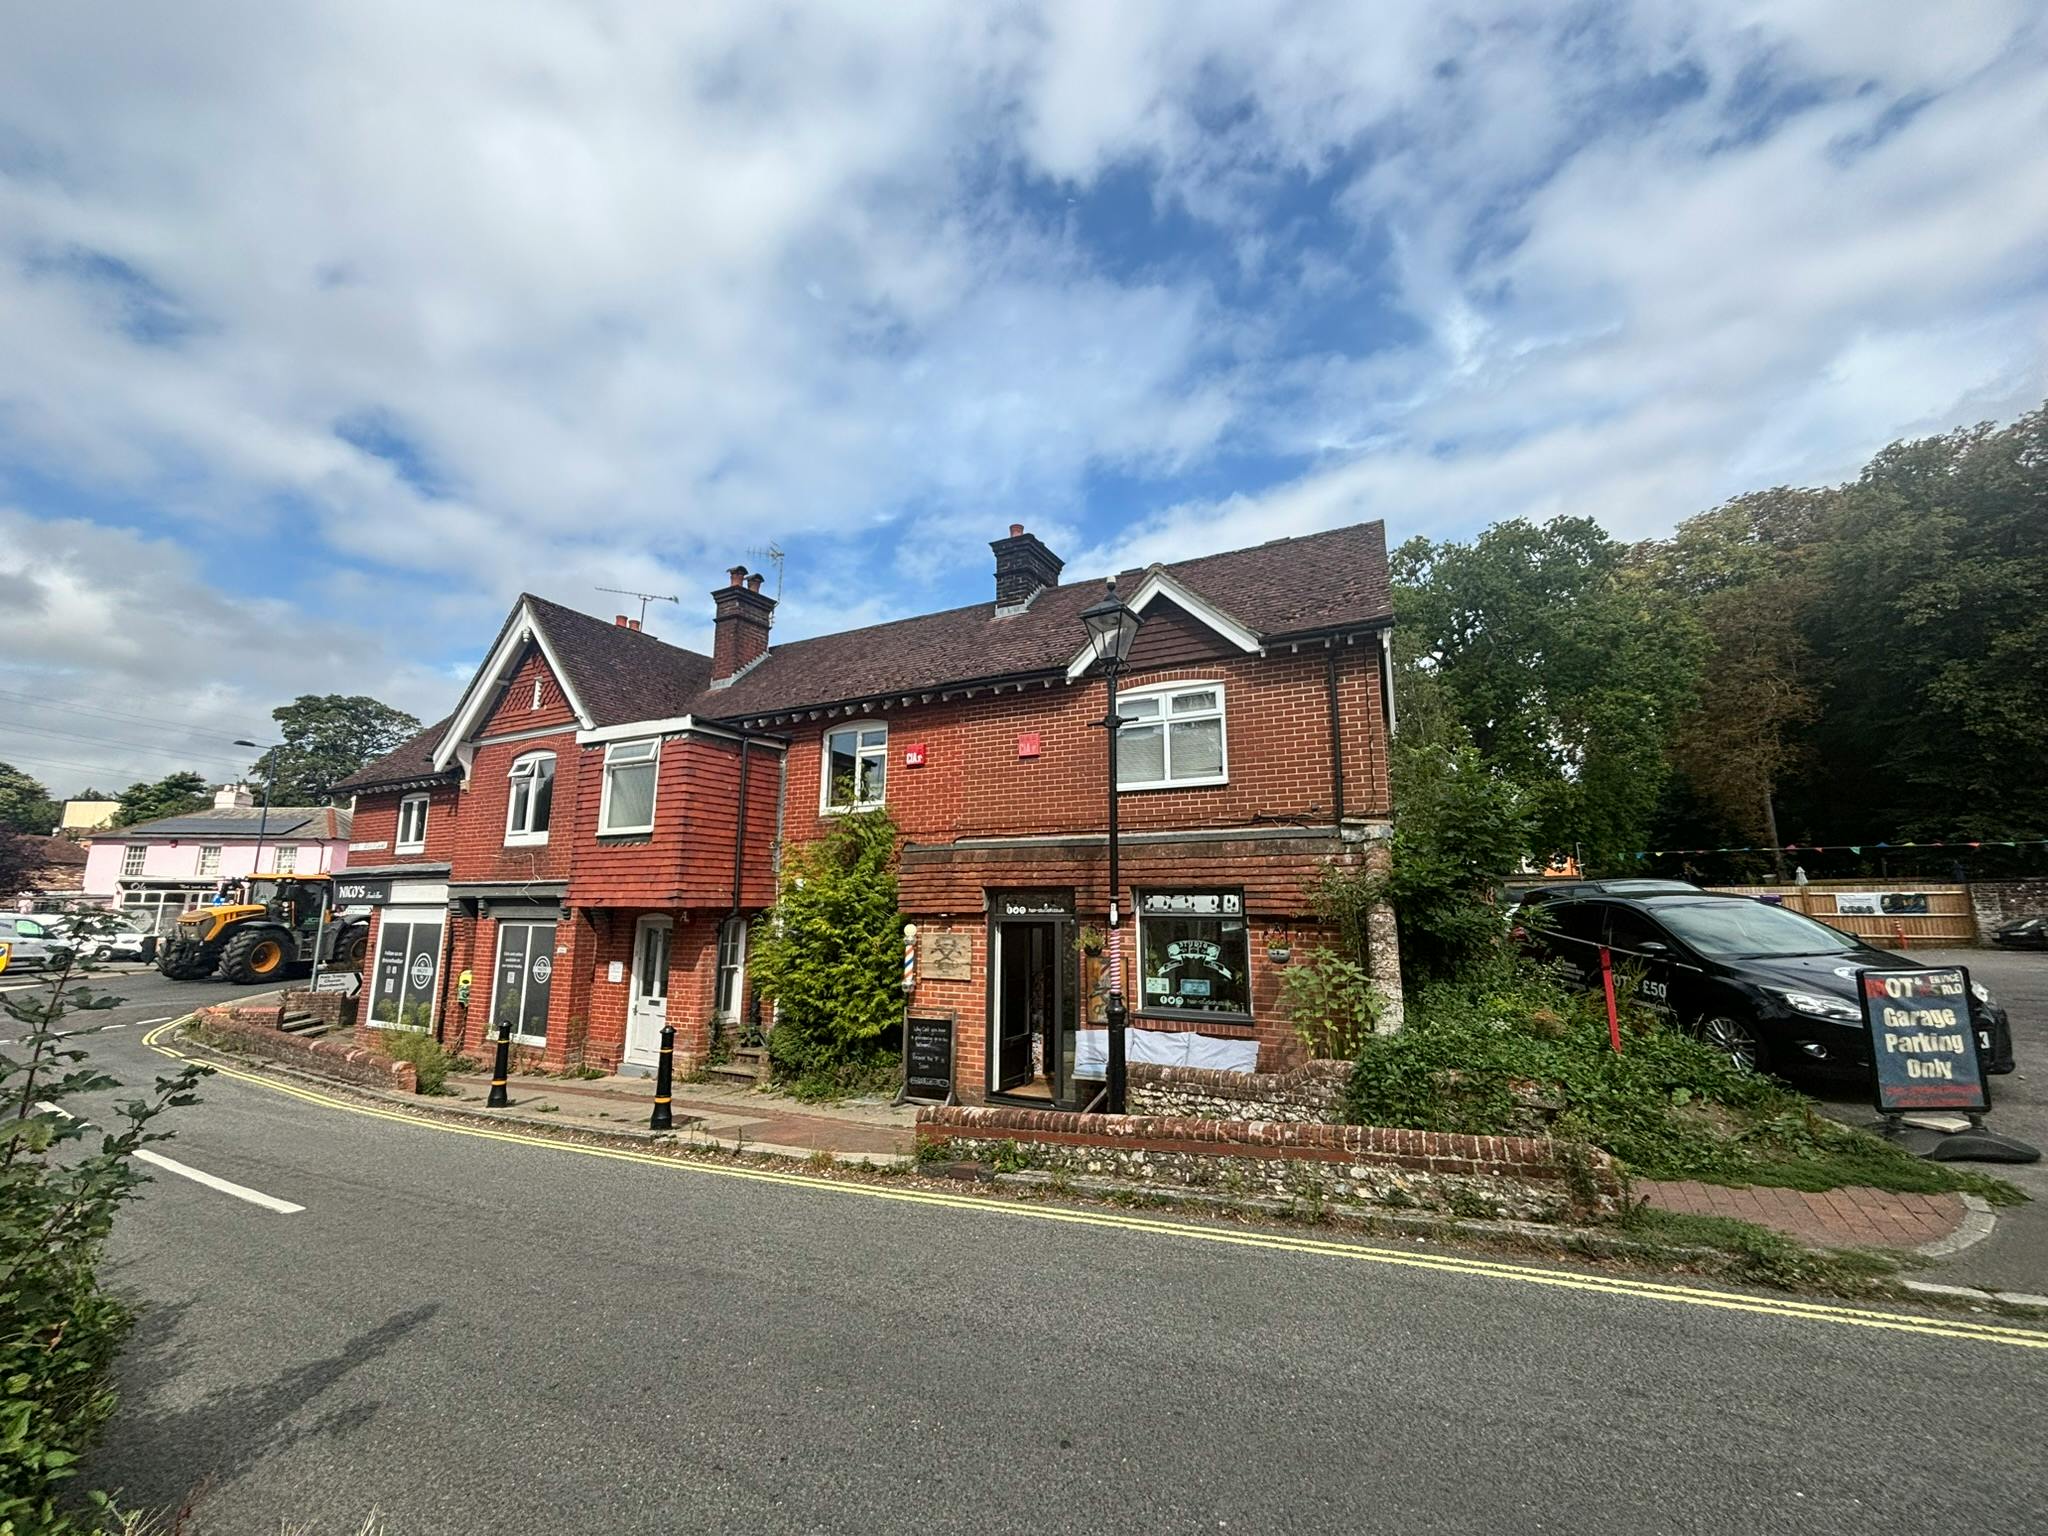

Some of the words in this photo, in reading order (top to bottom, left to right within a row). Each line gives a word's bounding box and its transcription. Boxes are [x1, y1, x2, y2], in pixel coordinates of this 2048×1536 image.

[339, 885, 365, 898] NICO'S
[1643, 980, 1667, 998] £50
[1883, 1007, 1957, 1028] Garage
[1884, 1032, 1965, 1054] Parking
[1906, 1058, 1953, 1080] Only
